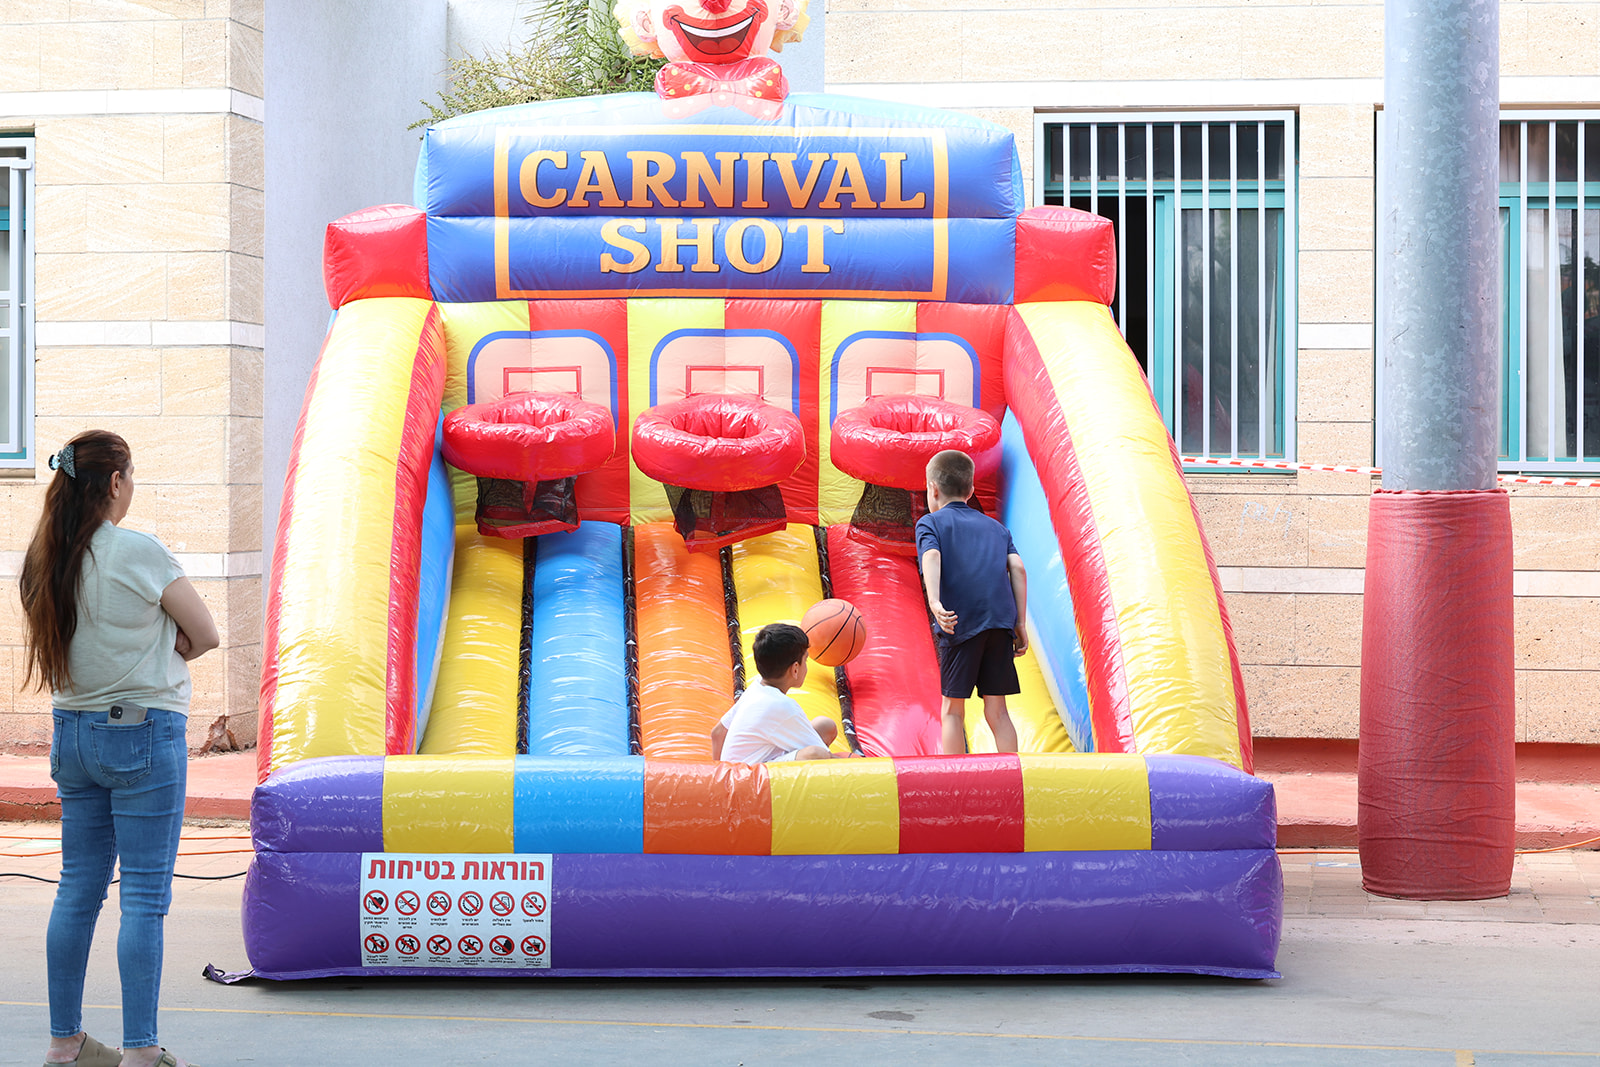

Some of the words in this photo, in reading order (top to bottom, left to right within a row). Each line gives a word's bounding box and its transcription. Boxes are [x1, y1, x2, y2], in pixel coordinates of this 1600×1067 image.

[518, 149, 927, 210] CARNIVAL
[599, 217, 845, 274] SHOT
[367, 859, 456, 881] בטיחות
[461, 861, 545, 881] הוראות
